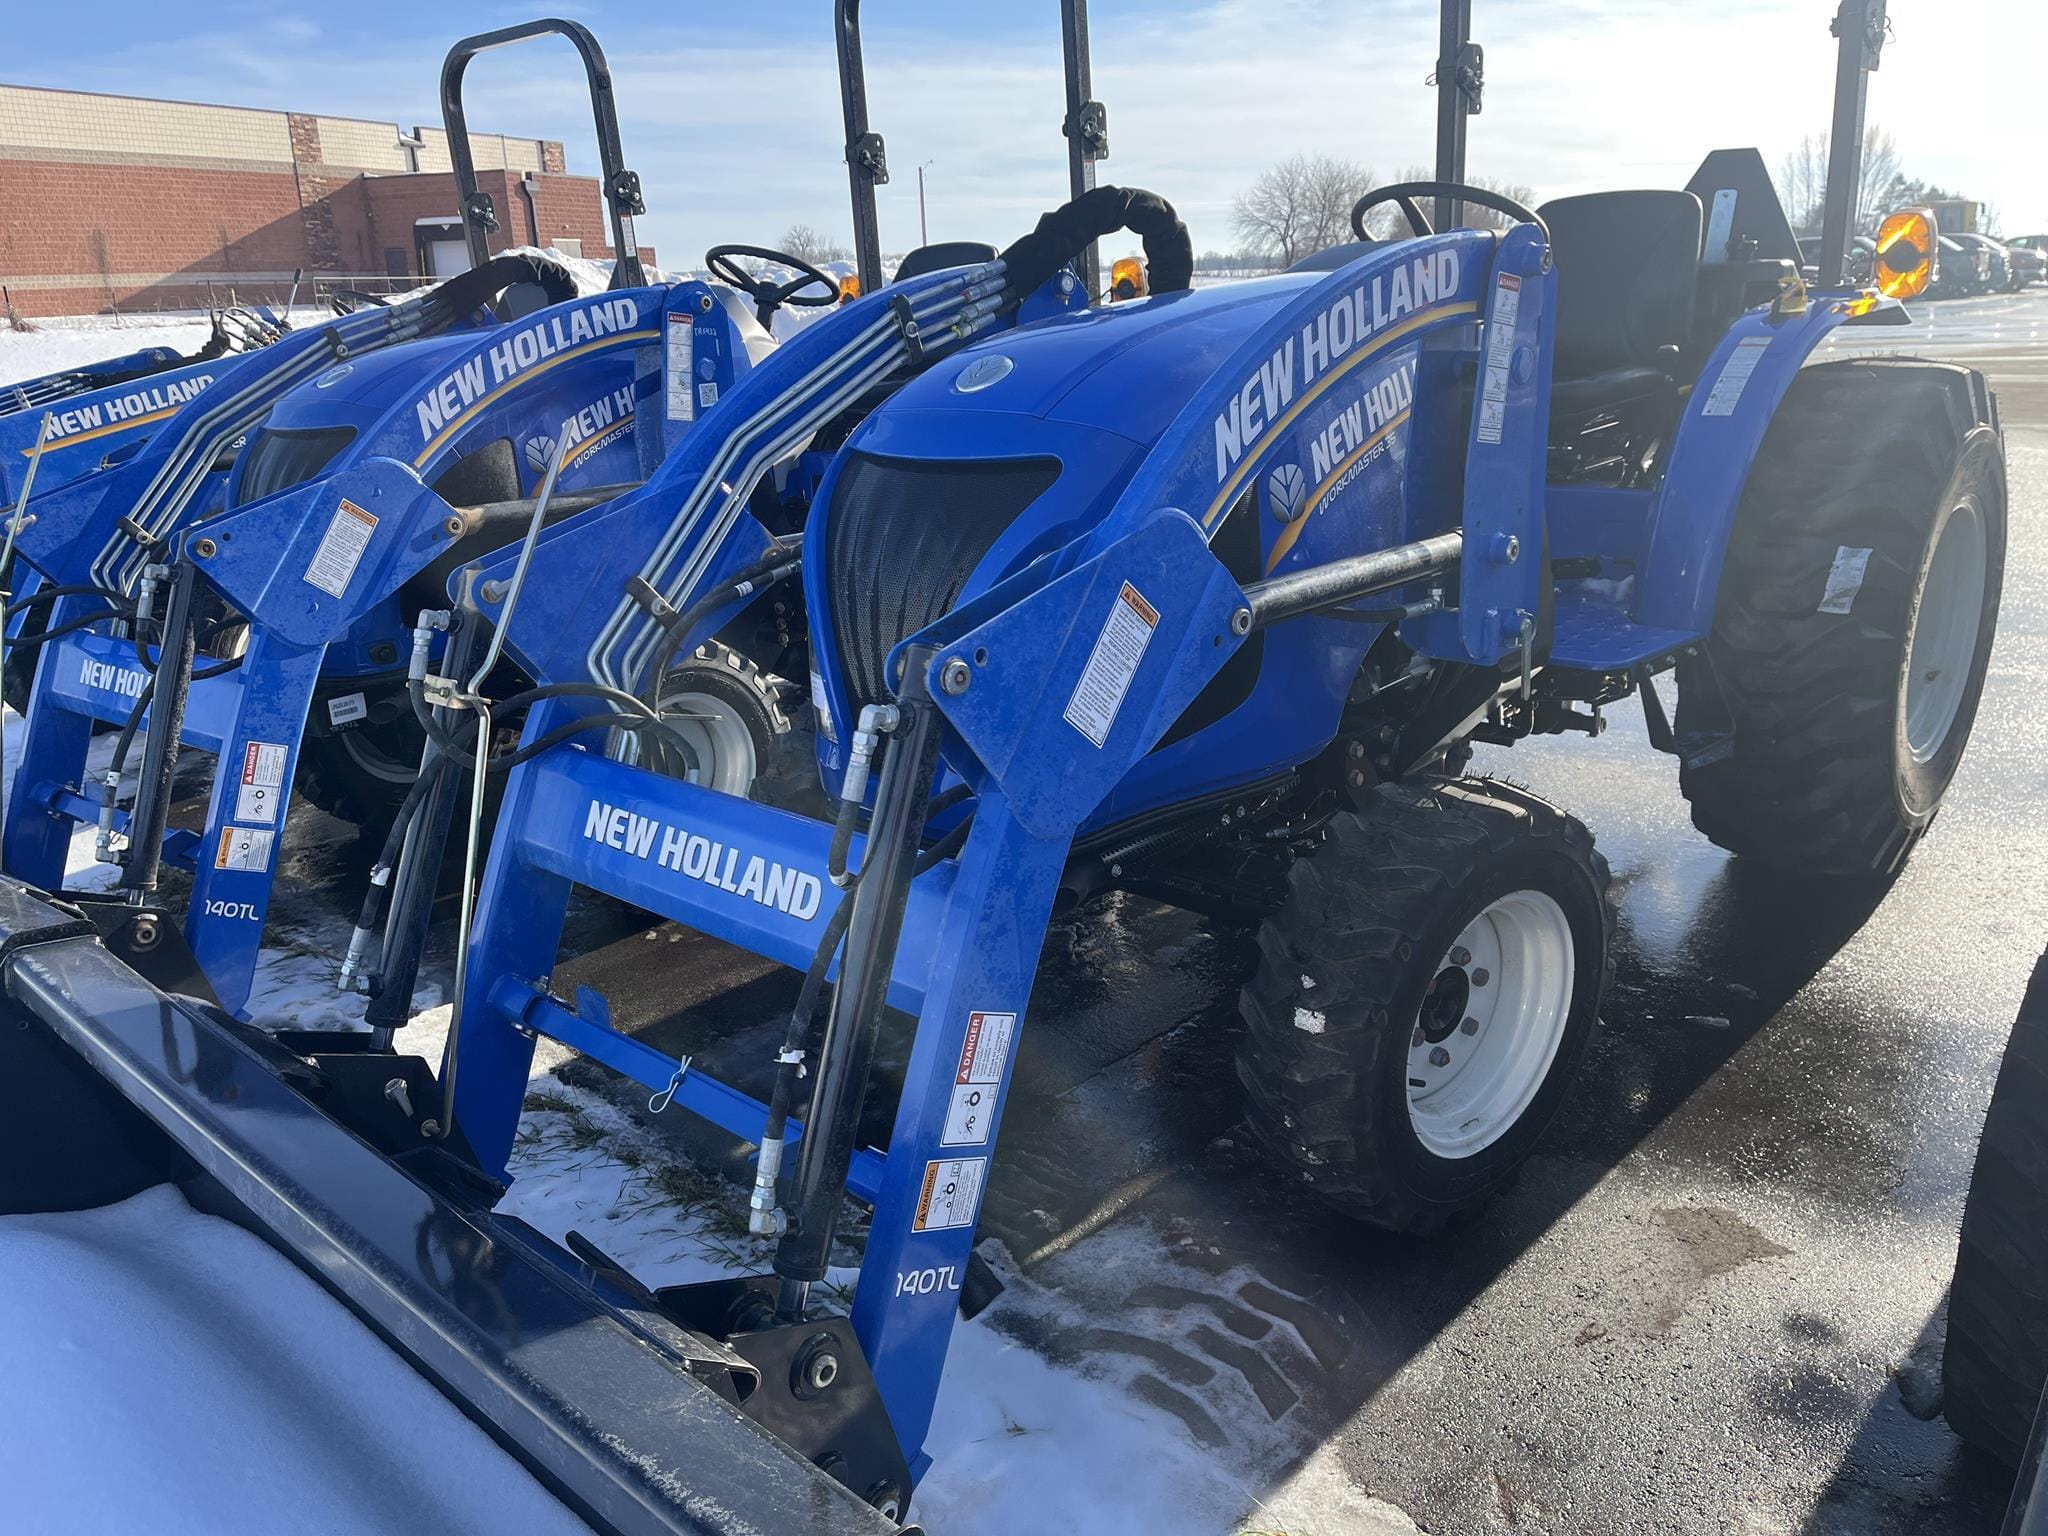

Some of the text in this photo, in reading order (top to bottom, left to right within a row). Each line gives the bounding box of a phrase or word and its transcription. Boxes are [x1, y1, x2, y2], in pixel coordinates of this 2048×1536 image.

[416, 354, 486, 442] NEW
[488, 297, 639, 384] HOLLAND
[1214, 336, 1294, 484] NEW
[1302, 249, 1460, 385] HOLLAND
[40, 404, 103, 440] NEW
[561, 395, 613, 450] NEW
[1310, 400, 1364, 485] NEW
[1353, 358, 1417, 433] HOLL
[1319, 431, 1397, 515] WORKMASTER 35
[1131, 596, 1154, 622] WARNING
[80, 658, 116, 690] NEW
[247, 745, 257, 774] DANGER
[583, 799, 823, 922] NEW HOLLAND
[205, 899, 259, 920] 140TL
[963, 1018, 980, 1066] DANGER
[920, 1168, 935, 1212] WARNING
[896, 1266, 960, 1298] 140TL
